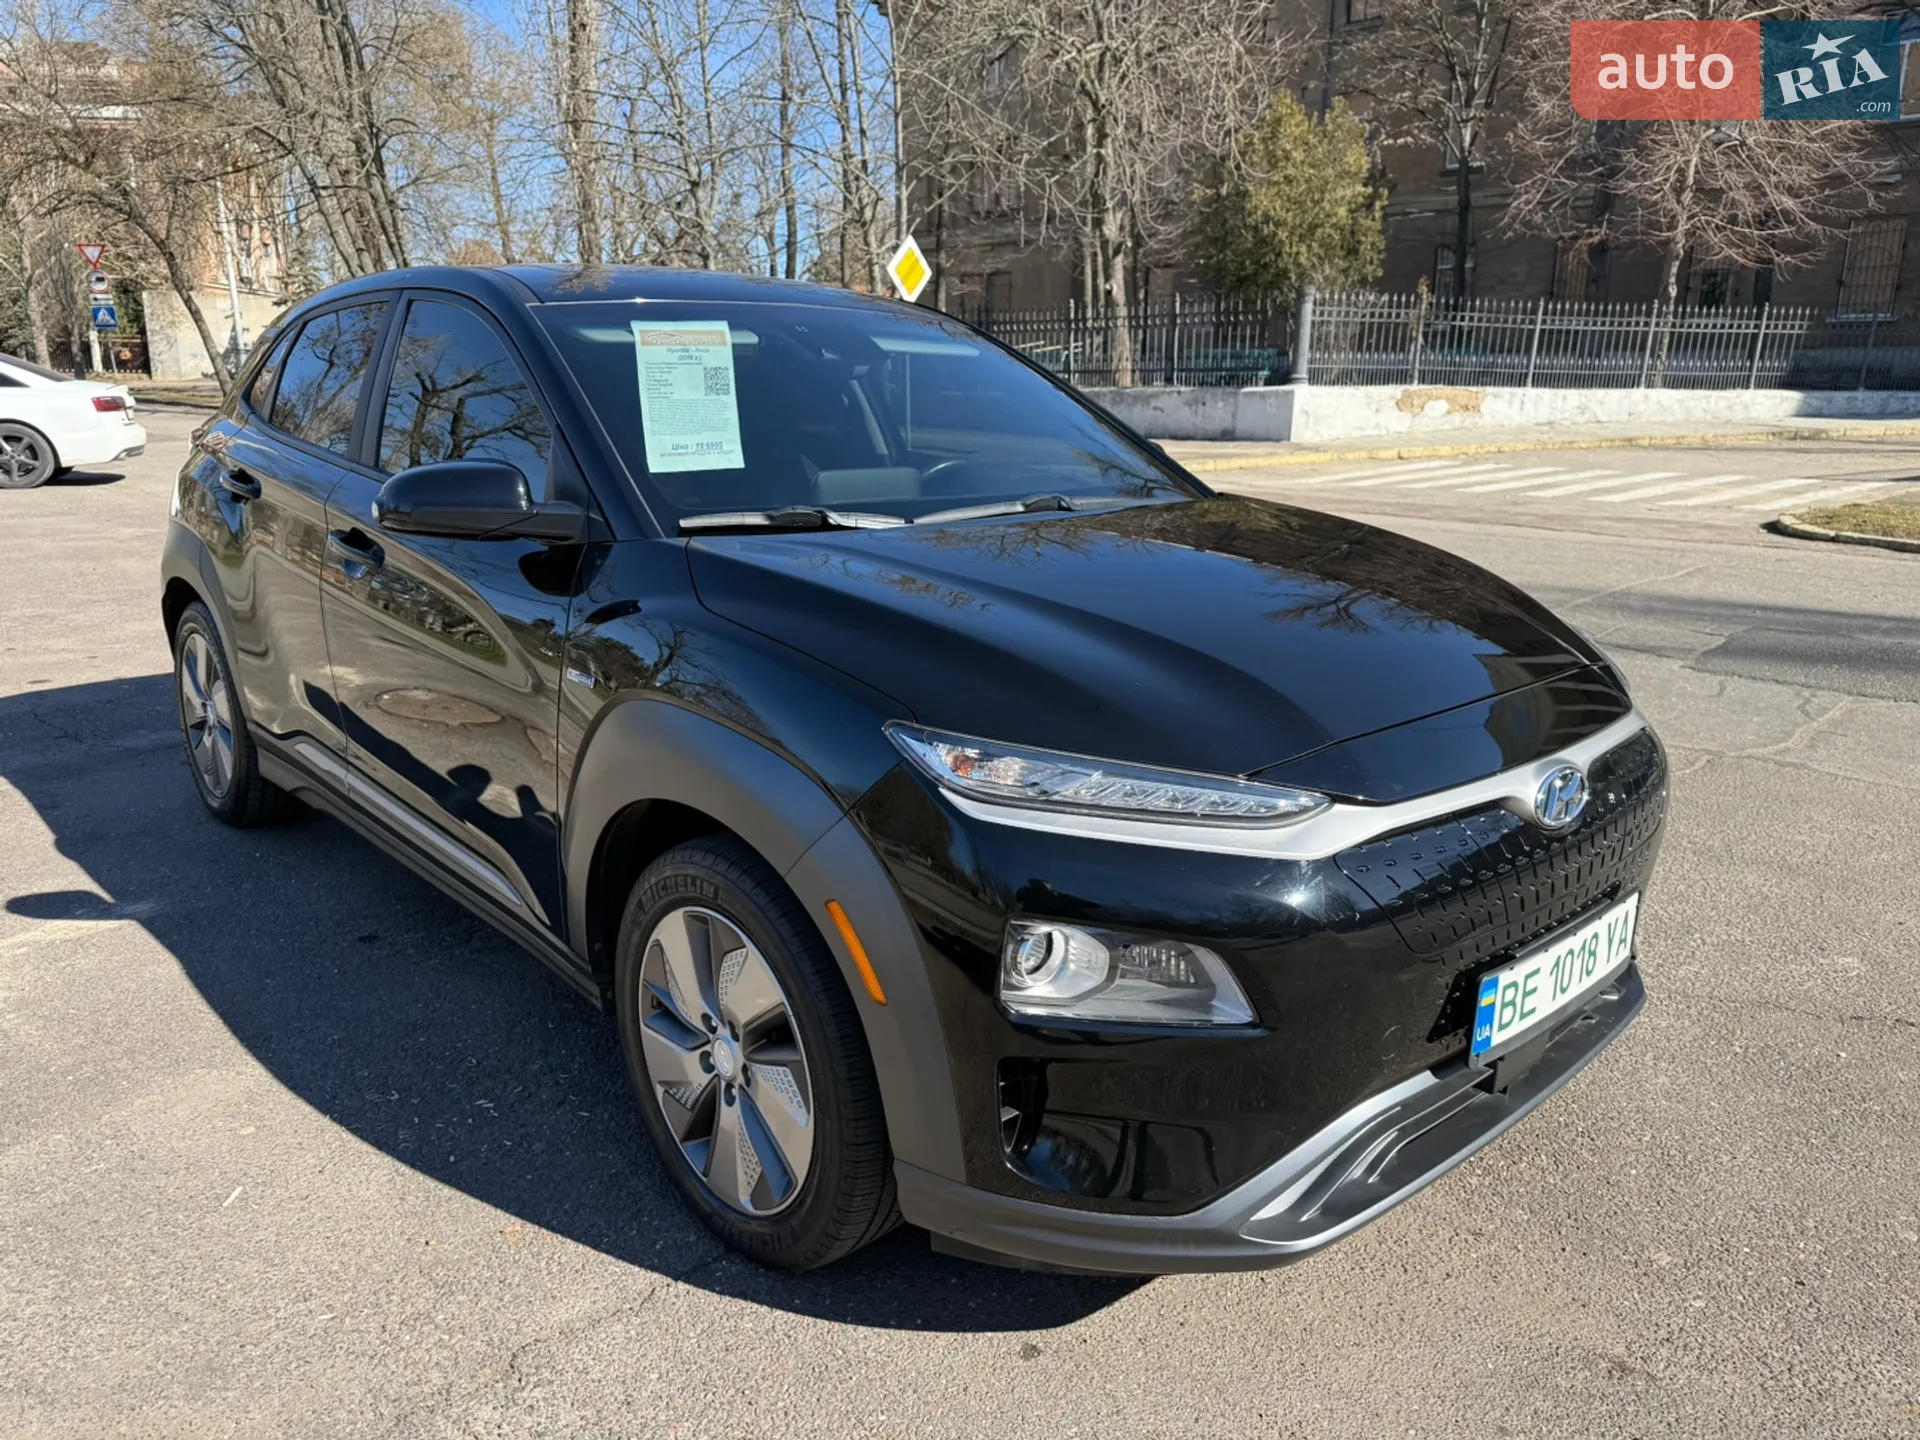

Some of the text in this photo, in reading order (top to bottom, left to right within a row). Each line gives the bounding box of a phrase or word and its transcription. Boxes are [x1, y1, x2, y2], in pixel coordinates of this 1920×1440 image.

[639, 874, 711, 912] MICHELIN
[1498, 967, 1541, 1032] BE
[1549, 931, 1599, 1001] 1018
[1476, 1027, 1491, 1041] UA
